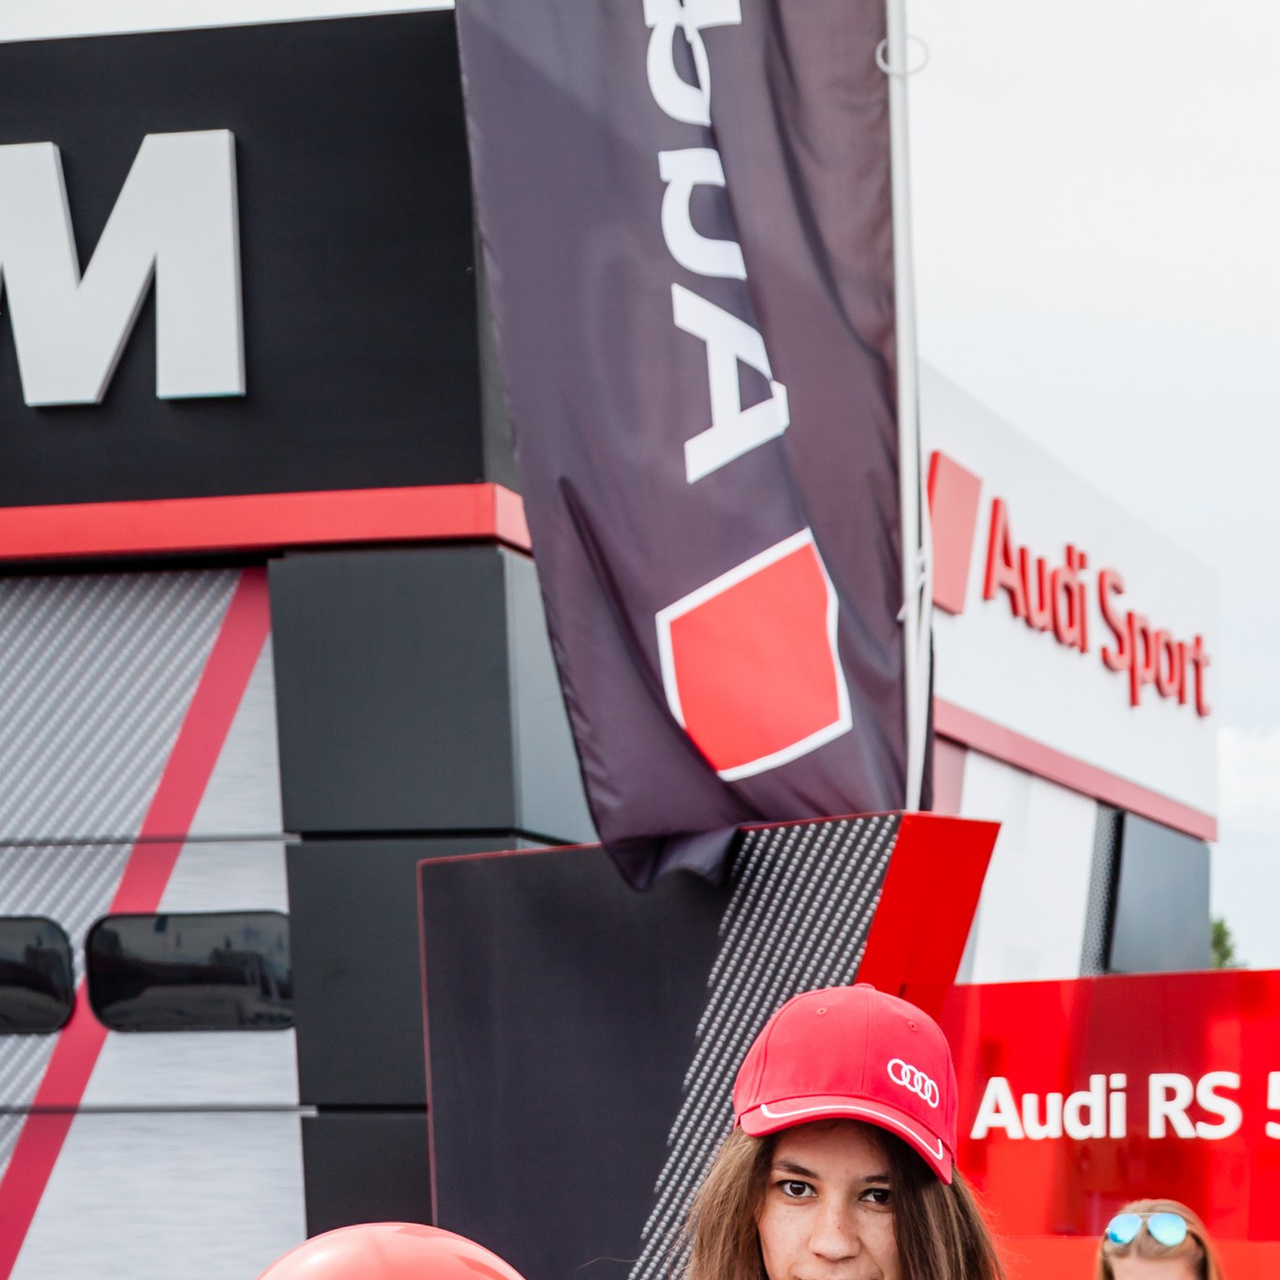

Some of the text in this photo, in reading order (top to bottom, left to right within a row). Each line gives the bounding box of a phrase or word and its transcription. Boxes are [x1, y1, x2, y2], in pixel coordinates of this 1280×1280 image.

[0, 129, 246, 407] M
[983, 498, 1211, 716] Audi Sport
[969, 1071, 1127, 1141] Audi
[1148, 1070, 1243, 1141] RS
